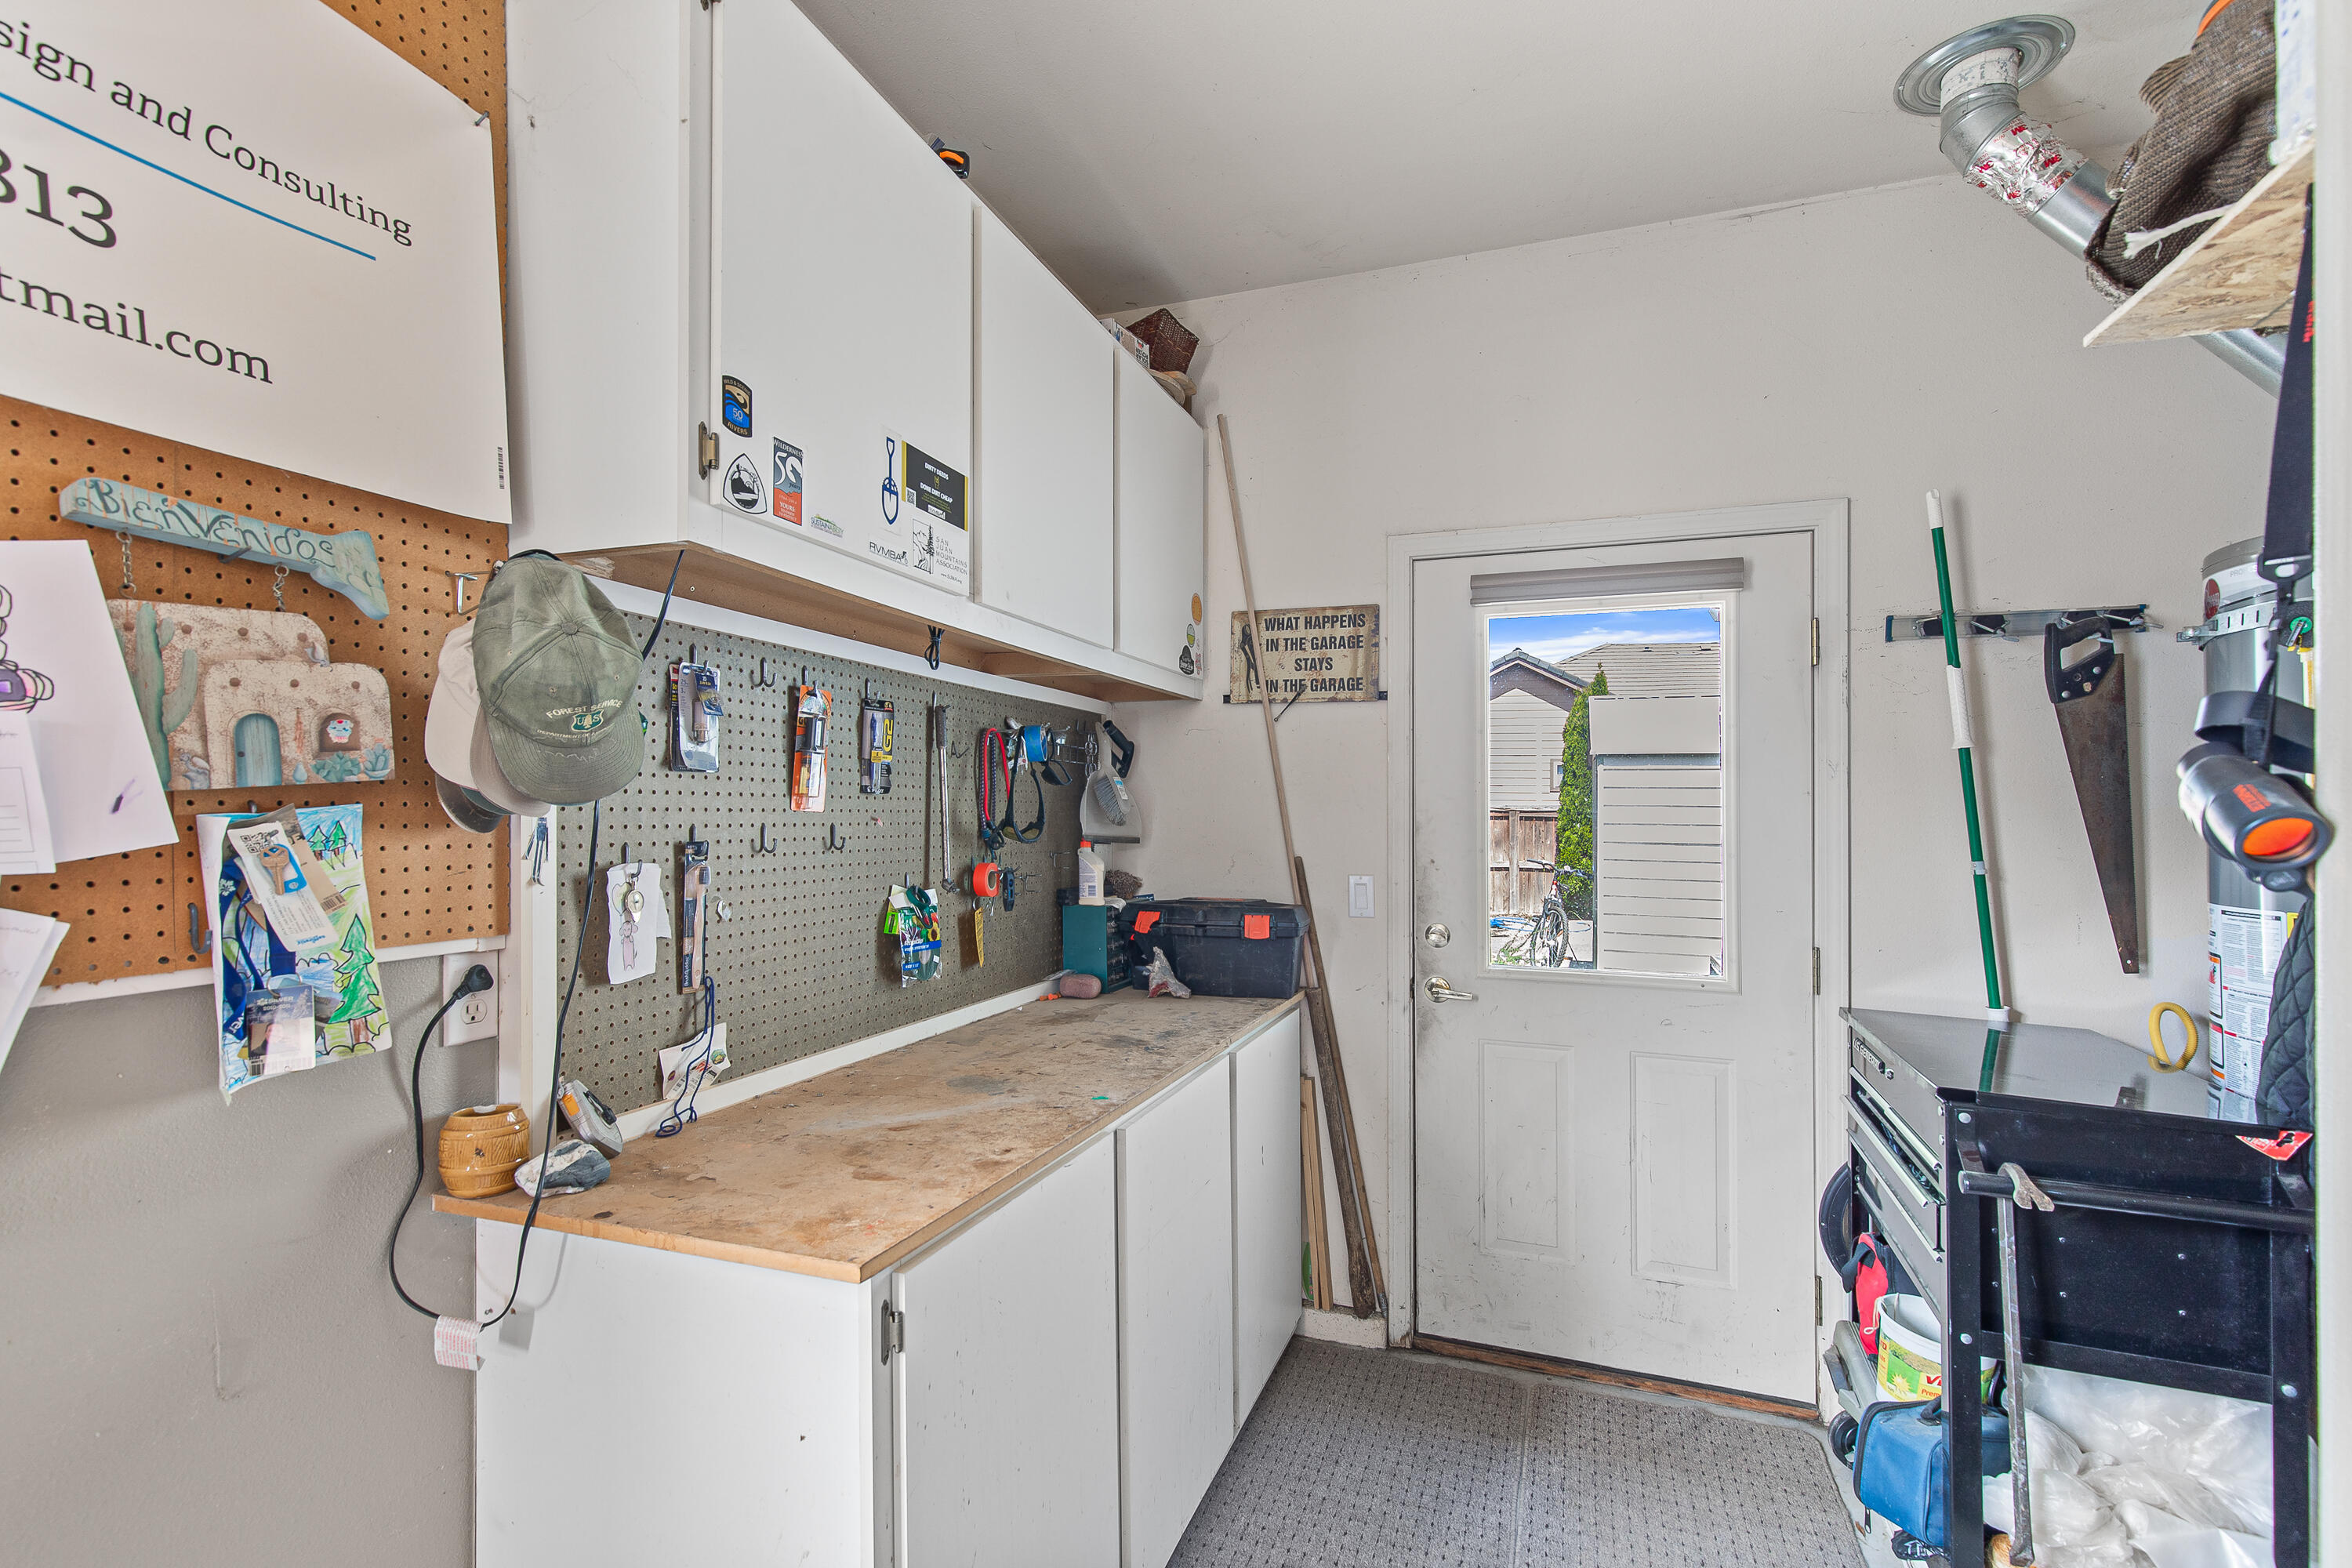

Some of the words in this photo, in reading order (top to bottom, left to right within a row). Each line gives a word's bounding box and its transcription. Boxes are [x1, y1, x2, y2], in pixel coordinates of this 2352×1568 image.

[111, 80, 191, 140] and
[205, 124, 412, 247] Consulting
[732, 408, 743, 419] 50
[727, 421, 748, 436] RIVERS
[774, 439, 804, 459] WILDERNESS
[924, 462, 936, 474] DIRTY
[936, 468, 949, 480] DEEDS
[920, 482, 931, 493] DONE
[940, 493, 953, 503] CHEAP
[935, 536, 949, 546] SAN
[936, 543, 953, 554] JUAN
[935, 550, 967, 568] MOUNTAINS
[935, 558, 967, 575] ASSOCIATION
[1264, 616, 1300, 631] WHAT
[1304, 613, 1366, 630] HAPPENS
[1265, 638, 1279, 652] IN
[1283, 637, 1307, 652] THE
[1310, 634, 1364, 651] GARAGE
[1294, 657, 1334, 672] STAYS
[1265, 679, 1279, 693] IN
[1283, 678, 1307, 692] THE
[1310, 677, 1363, 692] GARAGE
[546, 706, 587, 719] FOREST
[590, 699, 622, 710] SERVICE
[536, 729, 580, 739] DEPARTMENT
[883, 718, 894, 752] G2
